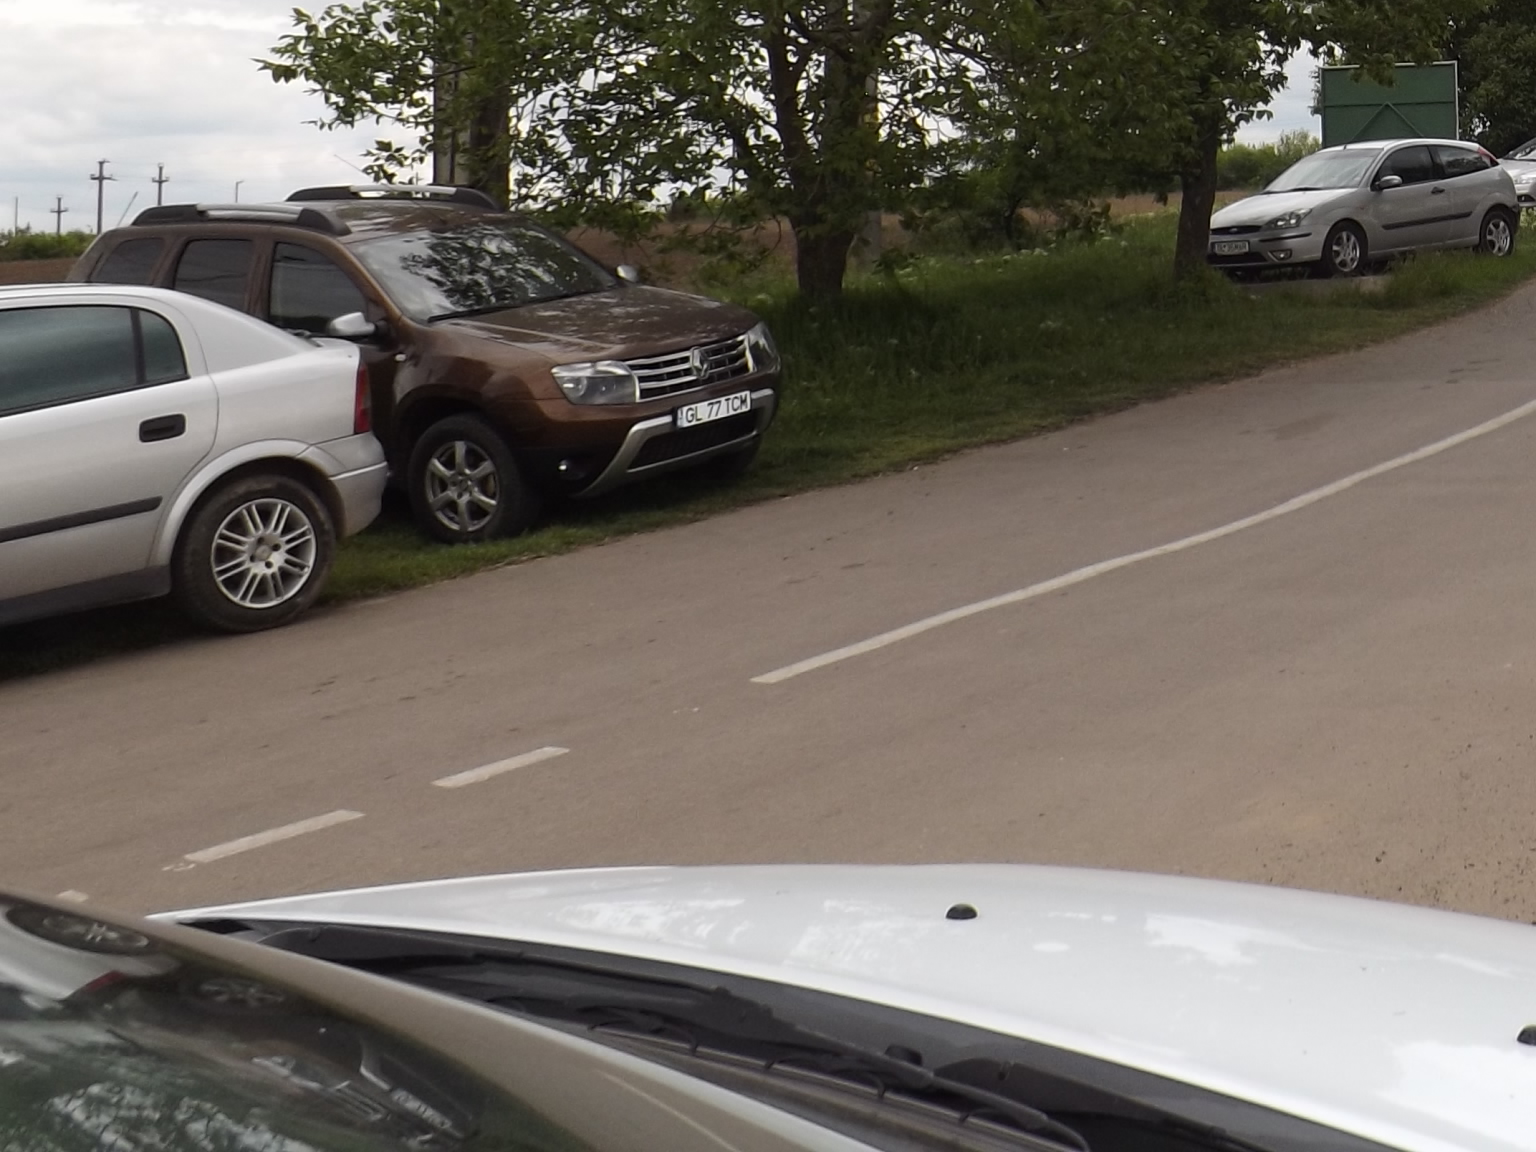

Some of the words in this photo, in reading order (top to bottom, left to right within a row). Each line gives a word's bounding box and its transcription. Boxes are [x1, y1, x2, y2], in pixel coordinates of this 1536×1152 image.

[685, 406, 703, 423] GL
[707, 400, 722, 419] 77
[724, 393, 748, 414] TCM
